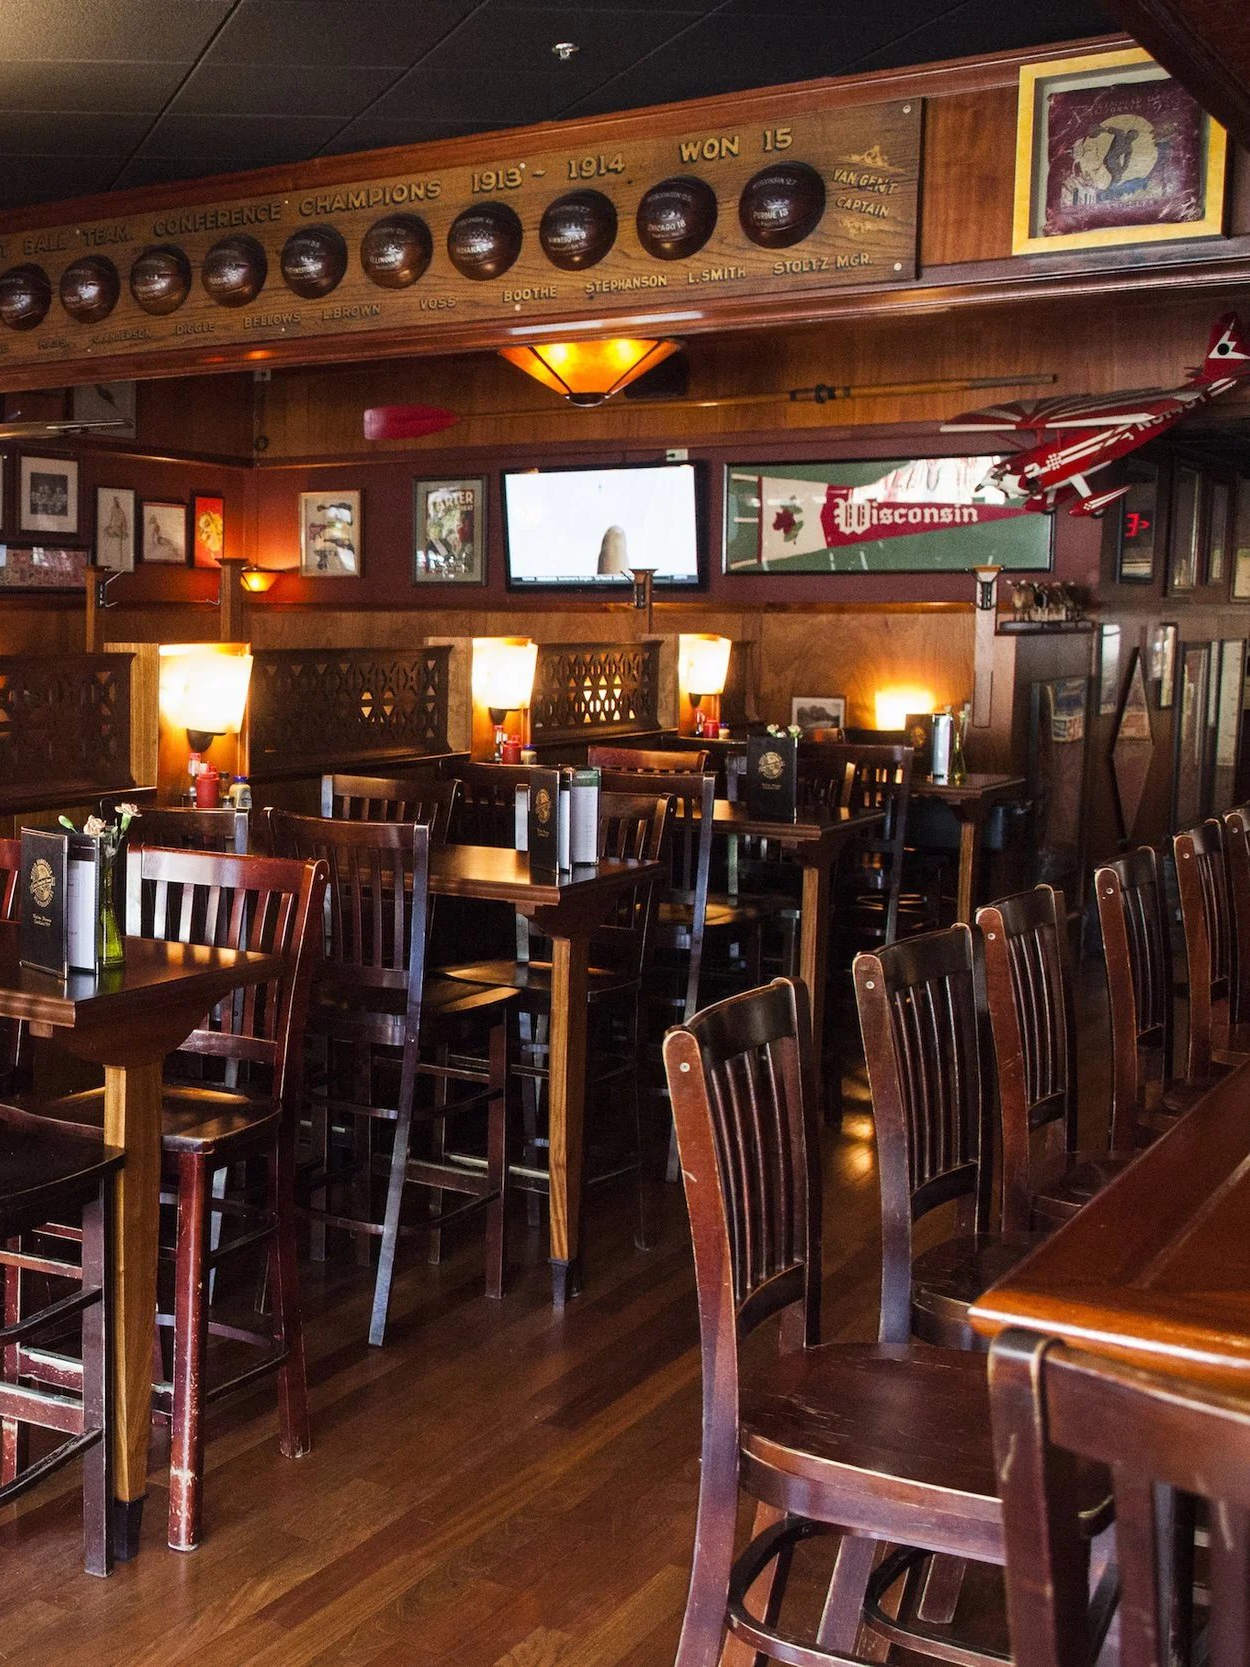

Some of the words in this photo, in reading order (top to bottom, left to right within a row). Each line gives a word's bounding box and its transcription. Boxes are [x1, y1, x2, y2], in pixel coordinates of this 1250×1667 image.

[22, 233, 67, 257] BALL
[153, 202, 282, 237] CONFERENCE
[299, 179, 443, 218] CHAMPIONS
[471, 167, 524, 194] 1913
[568, 155, 626, 181] 1914
[679, 134, 740, 164] WON
[763, 127, 794, 153] 15
[832, 167, 858, 188] VAN
[836, 195, 891, 219] CAPTAIN
[174, 321, 216, 336] DIGGLE
[243, 310, 302, 330] BELLOWS
[419, 296, 458, 312] VOSS
[503, 285, 558, 303] BOOTHE
[585, 274, 669, 295] STEPHANSON
[772, 255, 830, 277] STOLTZ
[835, 251, 875, 272] MGR.
[833, 497, 979, 536] Wisconsin
